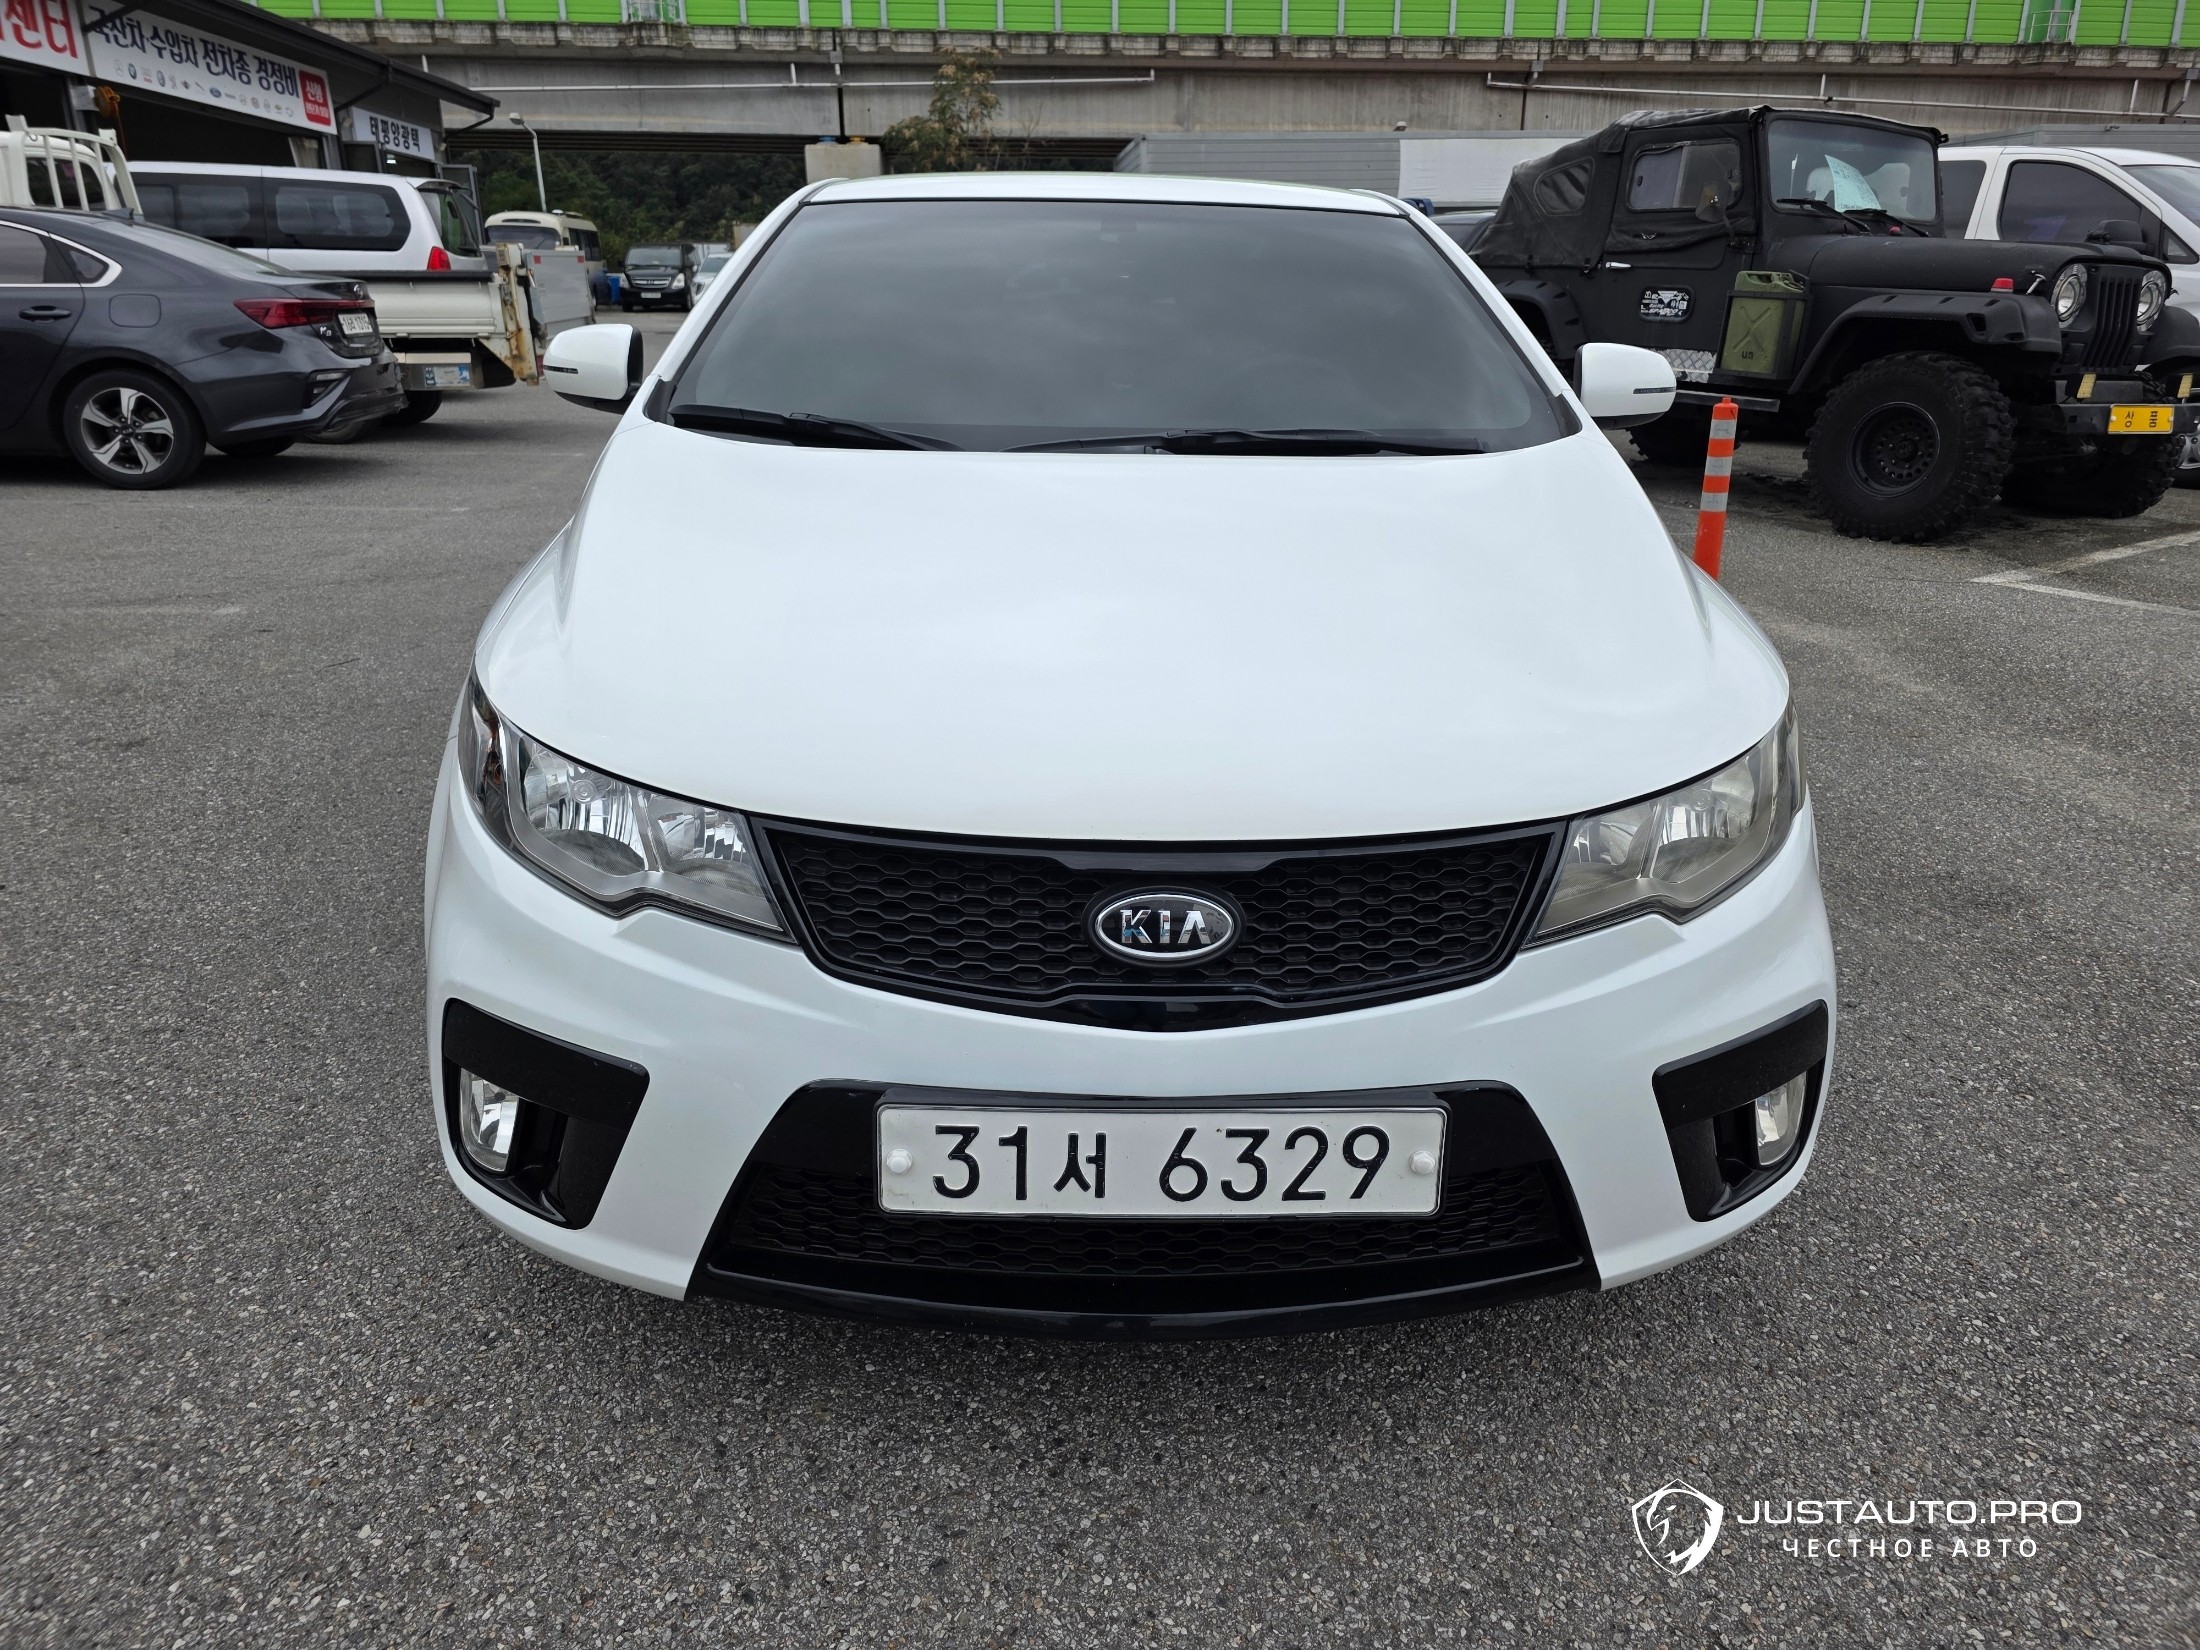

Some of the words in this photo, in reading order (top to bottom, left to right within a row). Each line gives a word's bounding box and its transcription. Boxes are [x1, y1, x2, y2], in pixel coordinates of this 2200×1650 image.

[0, 0, 78, 59] 센터
[199, 38, 251, 85] 전차종
[253, 54, 299, 98] 경정비
[369, 116, 420, 152] 태평양광택
[1120, 909, 1212, 944] KIA
[932, 1125, 1106, 1201] 31서
[1158, 1126, 1390, 1202] 6329
